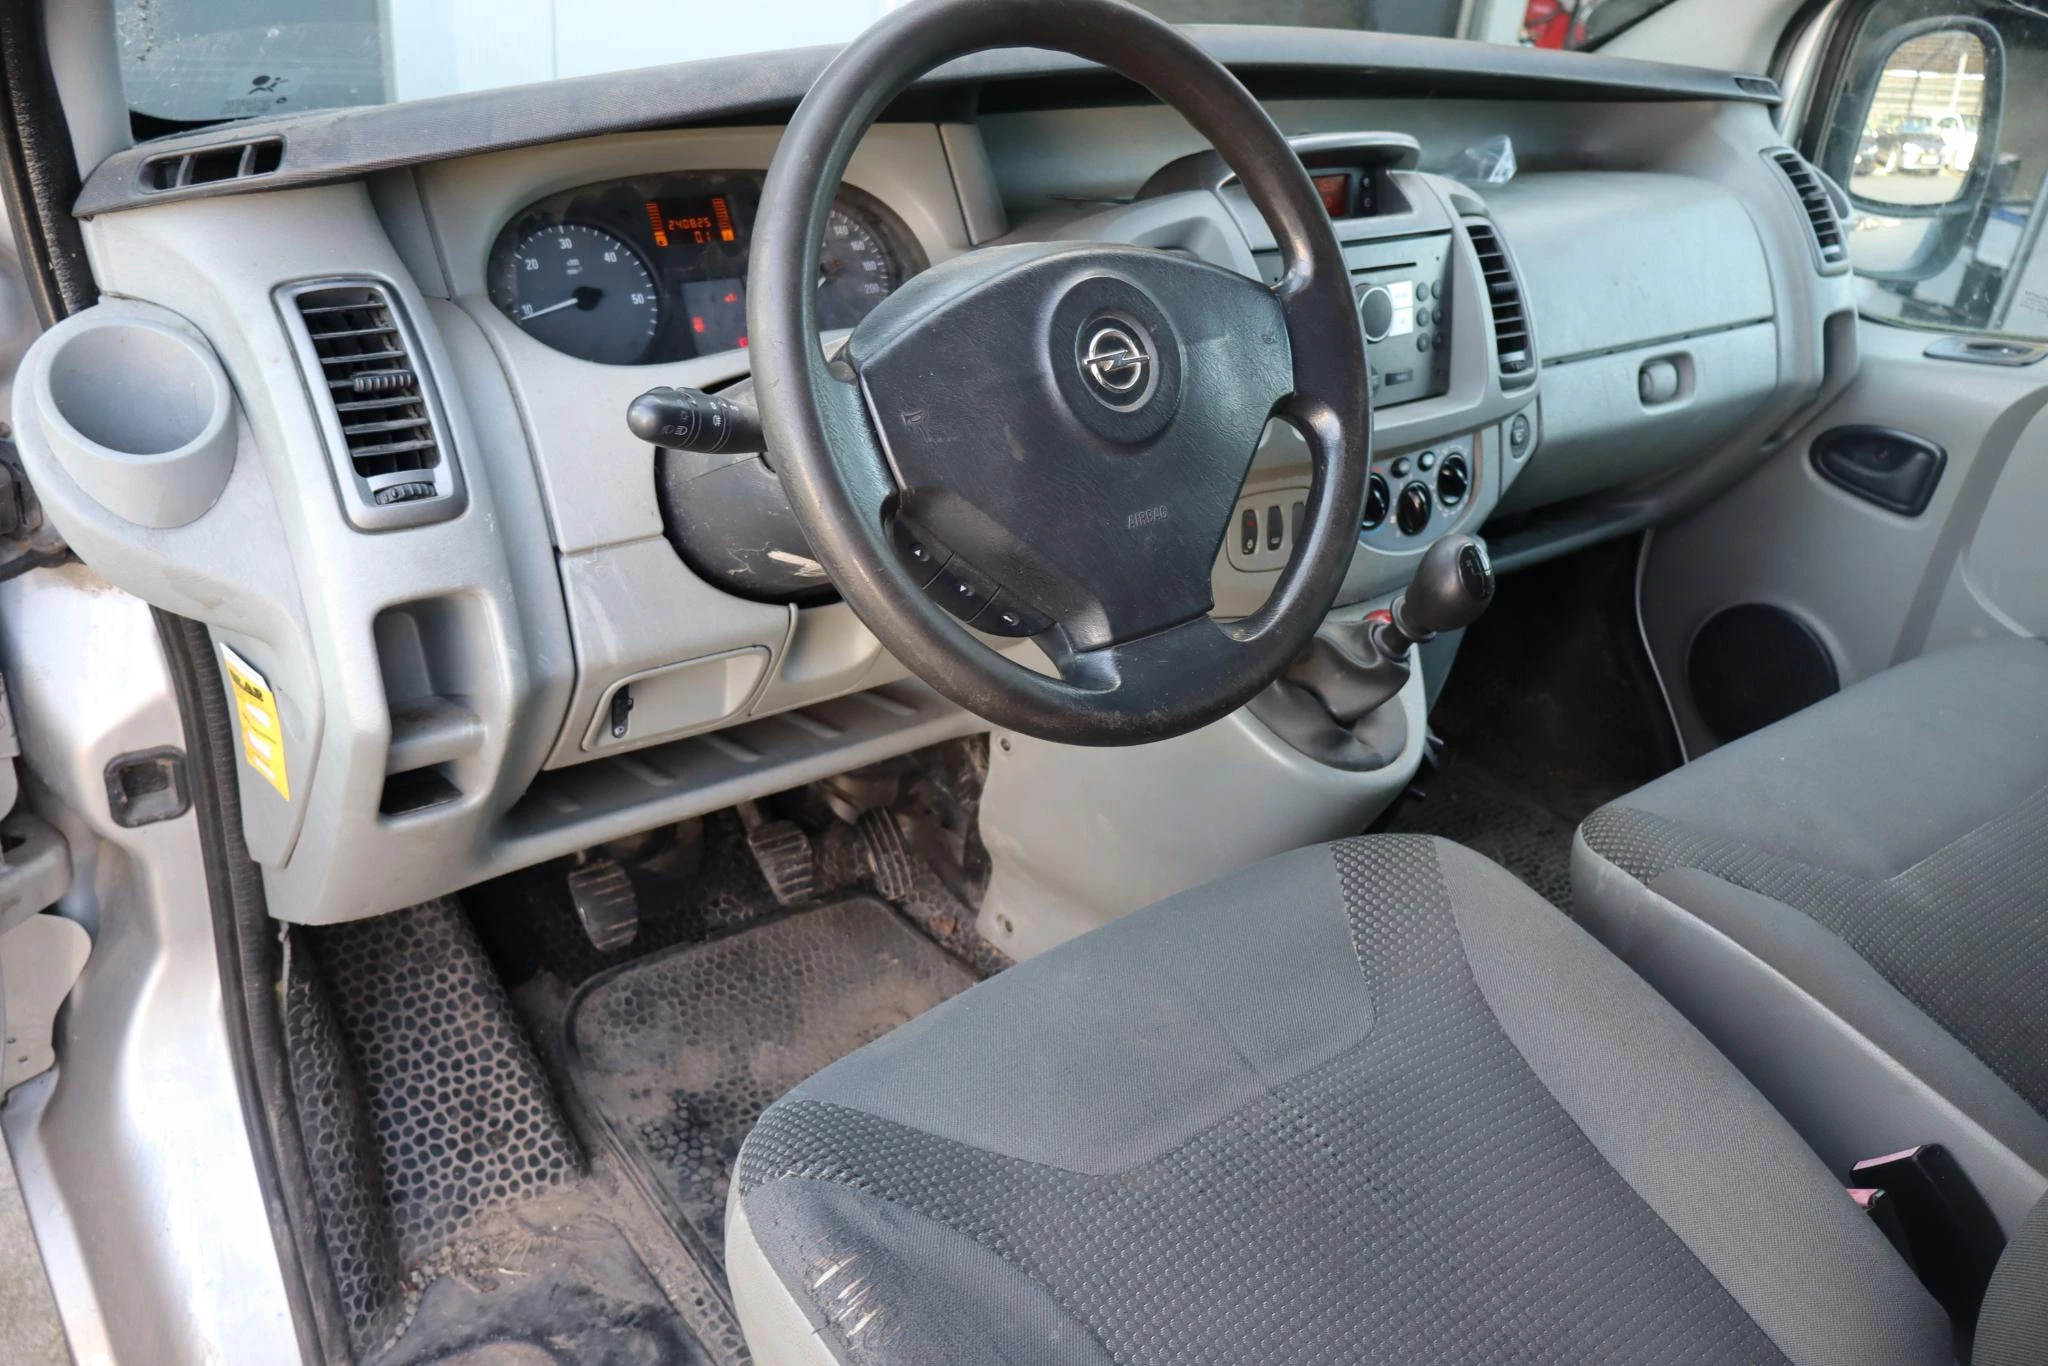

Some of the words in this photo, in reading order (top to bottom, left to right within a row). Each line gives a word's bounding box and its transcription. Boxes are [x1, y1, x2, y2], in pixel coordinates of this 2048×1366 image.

[668, 217, 711, 230] 240825
[558, 238, 572, 249] 30
[603, 251, 617, 263] 40
[525, 258, 539, 270] 20
[864, 283, 880, 294] 200
[631, 293, 645, 304] 50
[521, 304, 534, 317] 10
[1128, 505, 1168, 529] AIRBAG
